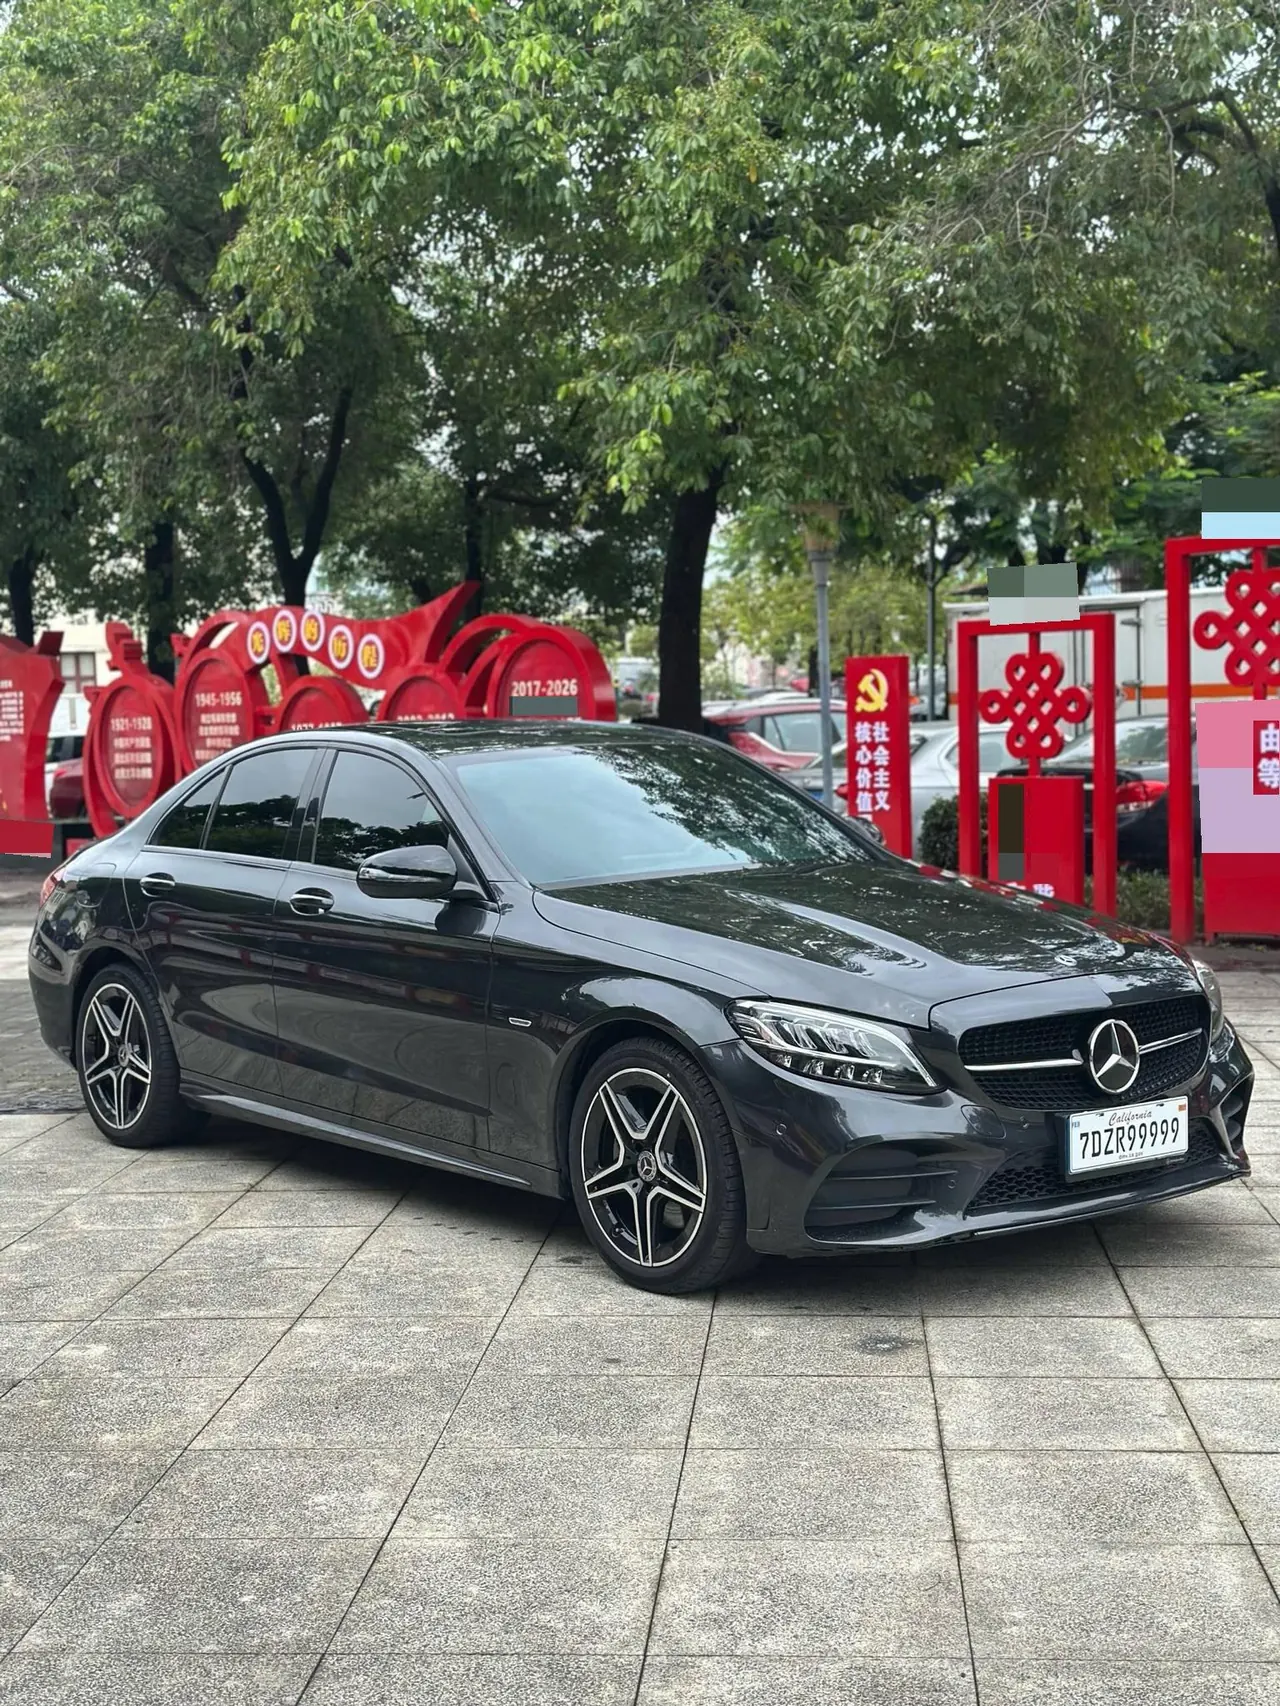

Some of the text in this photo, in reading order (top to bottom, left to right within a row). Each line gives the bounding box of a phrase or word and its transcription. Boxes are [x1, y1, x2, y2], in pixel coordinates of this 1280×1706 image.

[511, 678, 578, 697] 2017-2026
[873, 721, 890, 811] 社会主义
[1108, 1110, 1152, 1126] California
[1080, 1117, 1179, 1159] 7DZR99999
